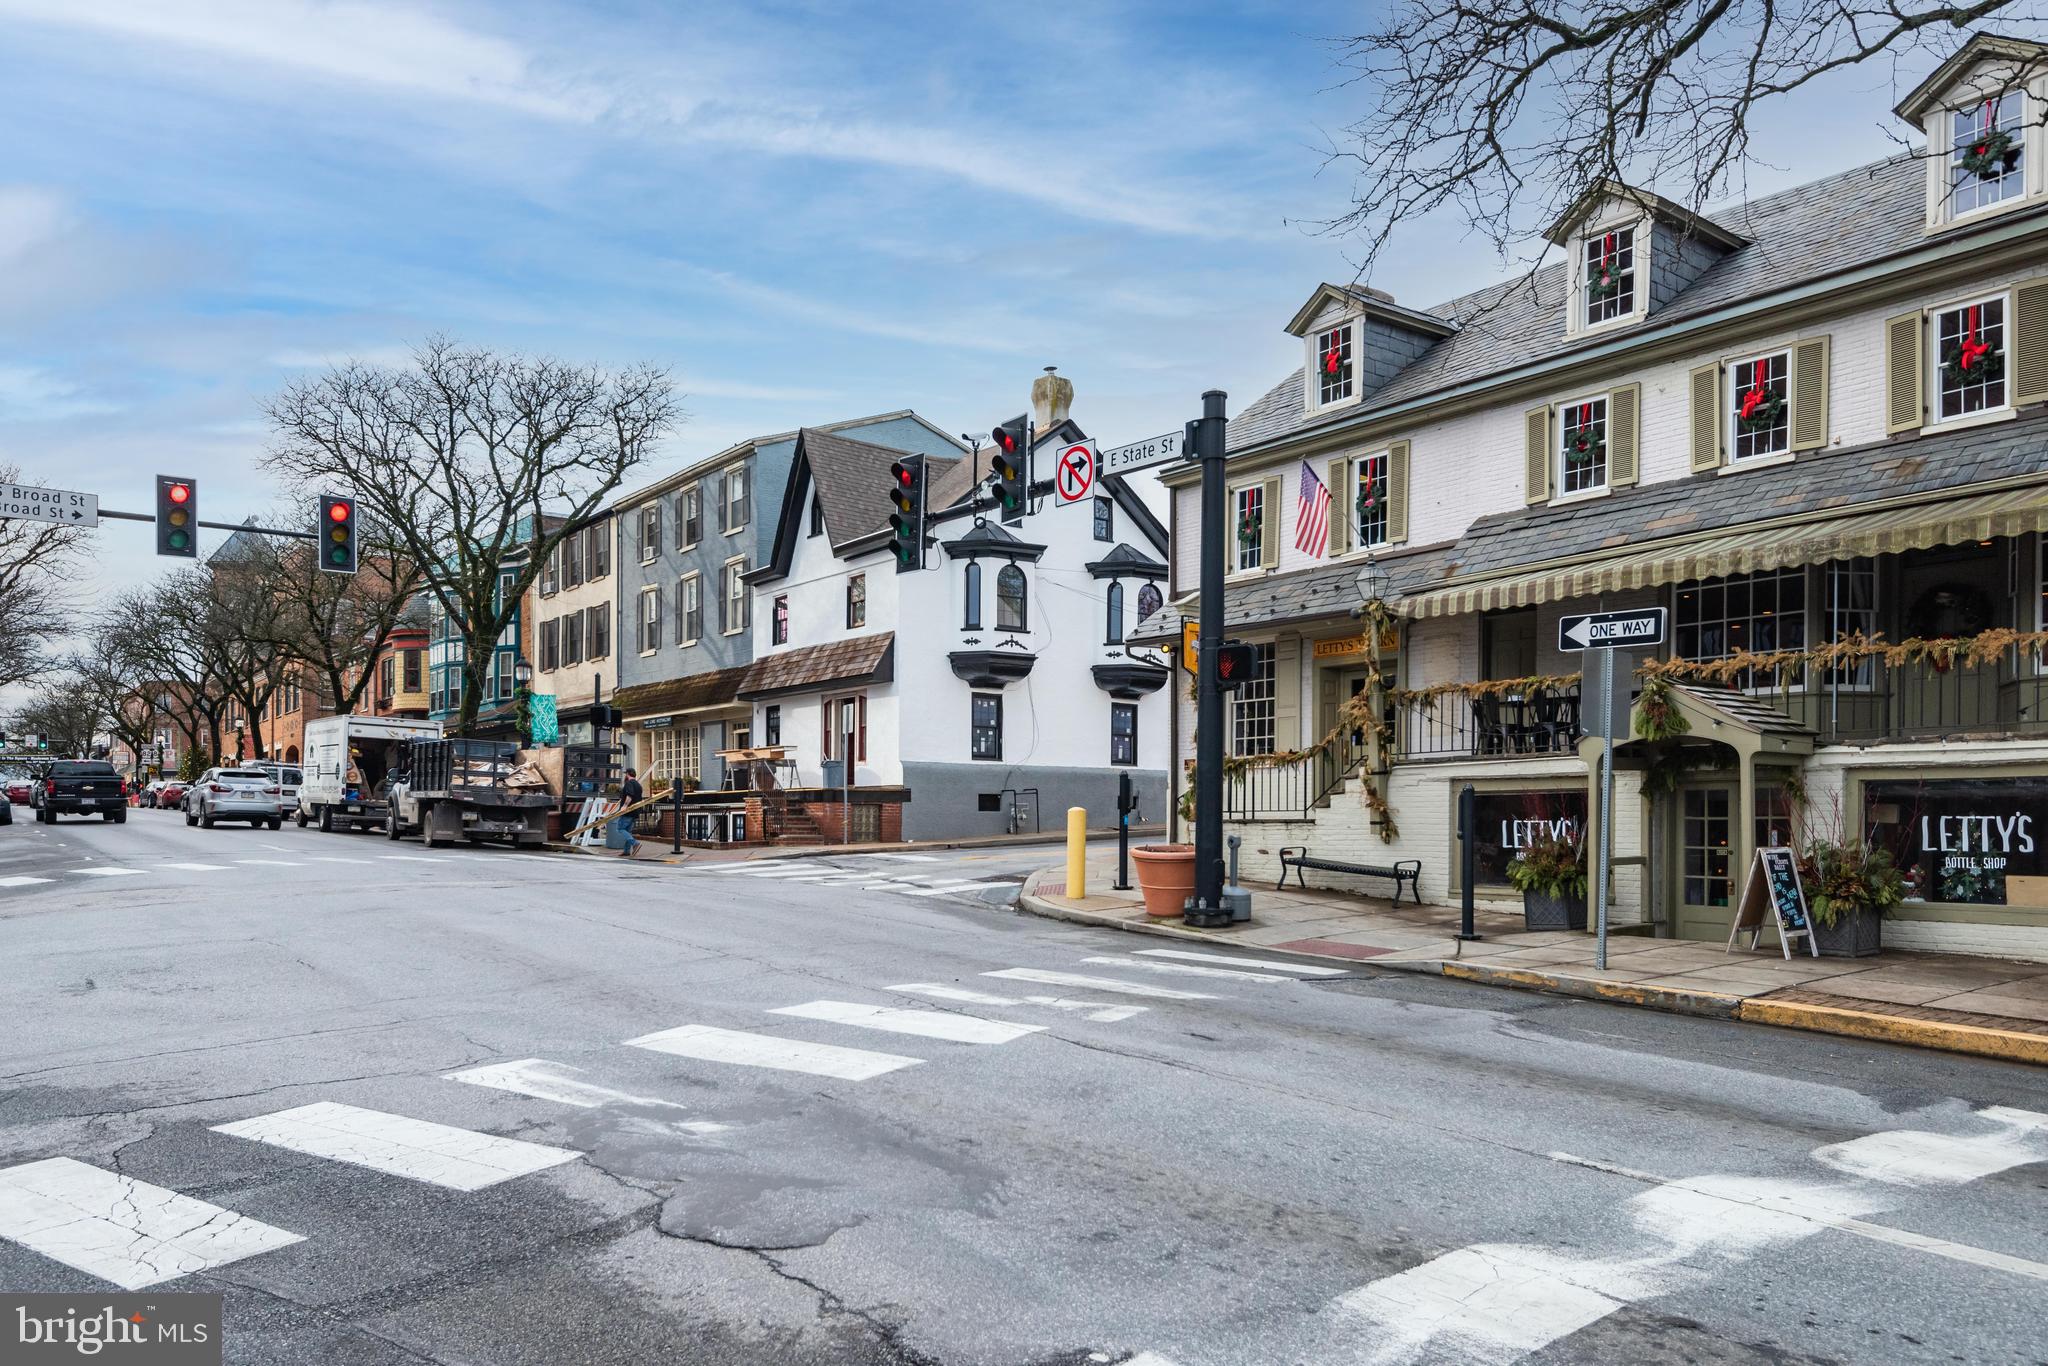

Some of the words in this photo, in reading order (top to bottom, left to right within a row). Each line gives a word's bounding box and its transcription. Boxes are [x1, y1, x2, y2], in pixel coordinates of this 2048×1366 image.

[1110, 452, 1117, 467] E
[1122, 444, 1155, 465] State
[1161, 437, 1174, 454] St
[12, 487, 60, 504] Broad
[70, 494, 85, 507] St
[0, 502, 40, 516] road
[49, 507, 64, 519] St
[1590, 623, 1617, 638] ONE
[1622, 620, 1651, 636] WAY
[1316, 640, 1354, 655] LETTY'S
[1921, 811, 2034, 853] LETTY'S
[1945, 856, 1977, 869] BOTTLE
[1983, 857, 2007, 869] SHOP
